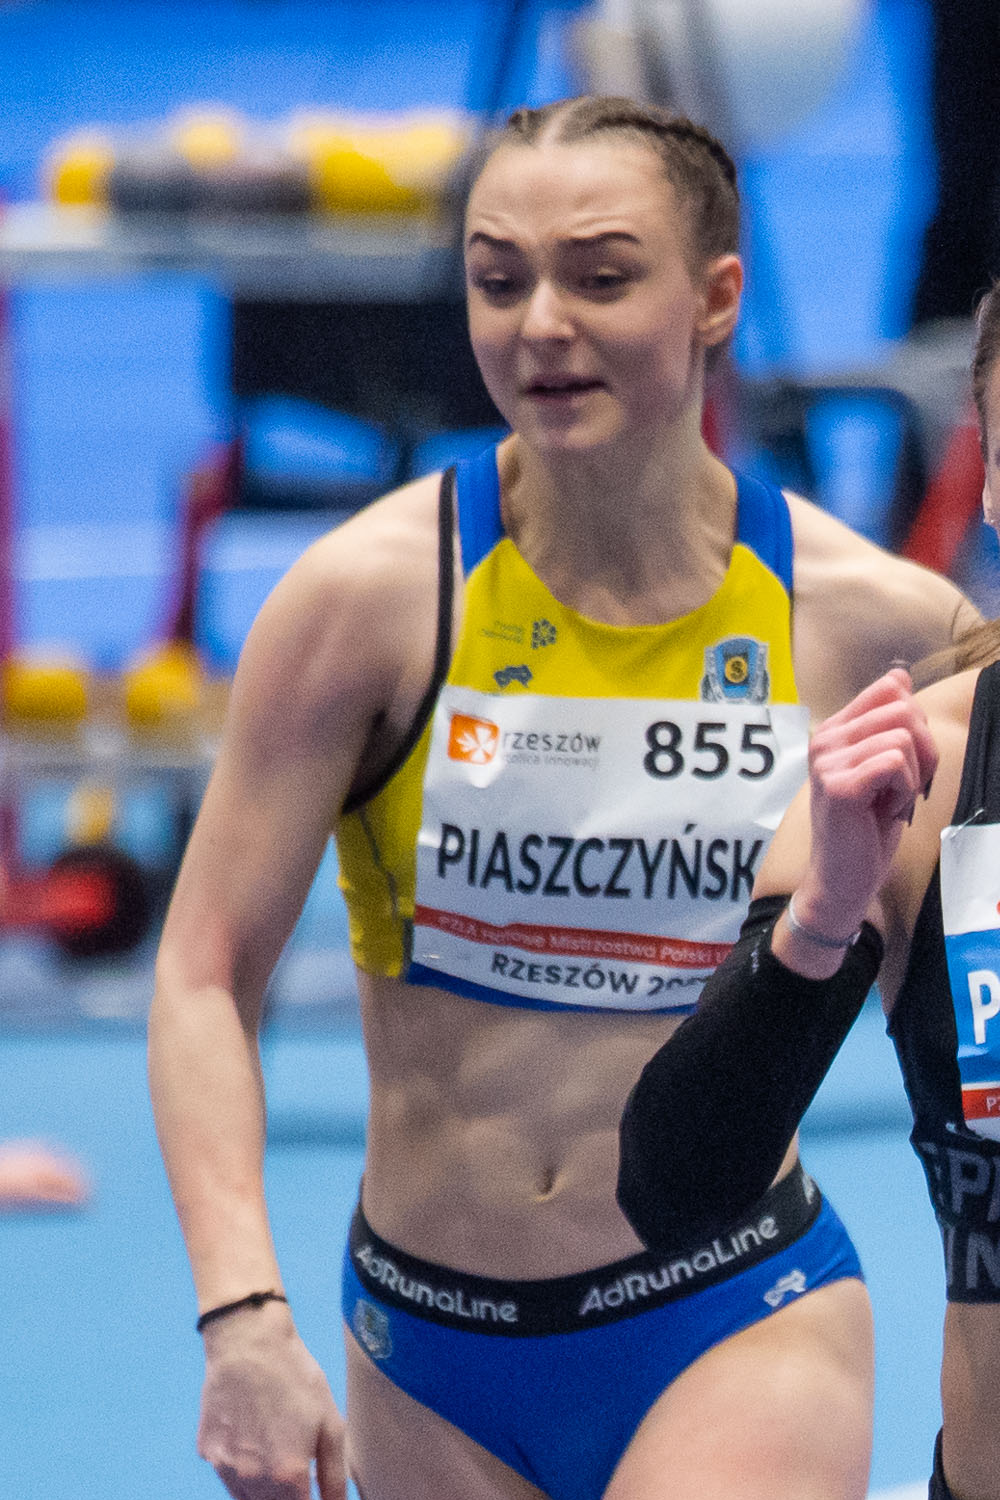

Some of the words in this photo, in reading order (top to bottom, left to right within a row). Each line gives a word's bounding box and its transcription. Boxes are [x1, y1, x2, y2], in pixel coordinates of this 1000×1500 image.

[643, 721, 776, 781] 855
[437, 823, 765, 900] PIASZCZYŃSK
[491, 952, 639, 995] RZESZÓW
[579, 1216, 779, 1316] AdRunaLine
